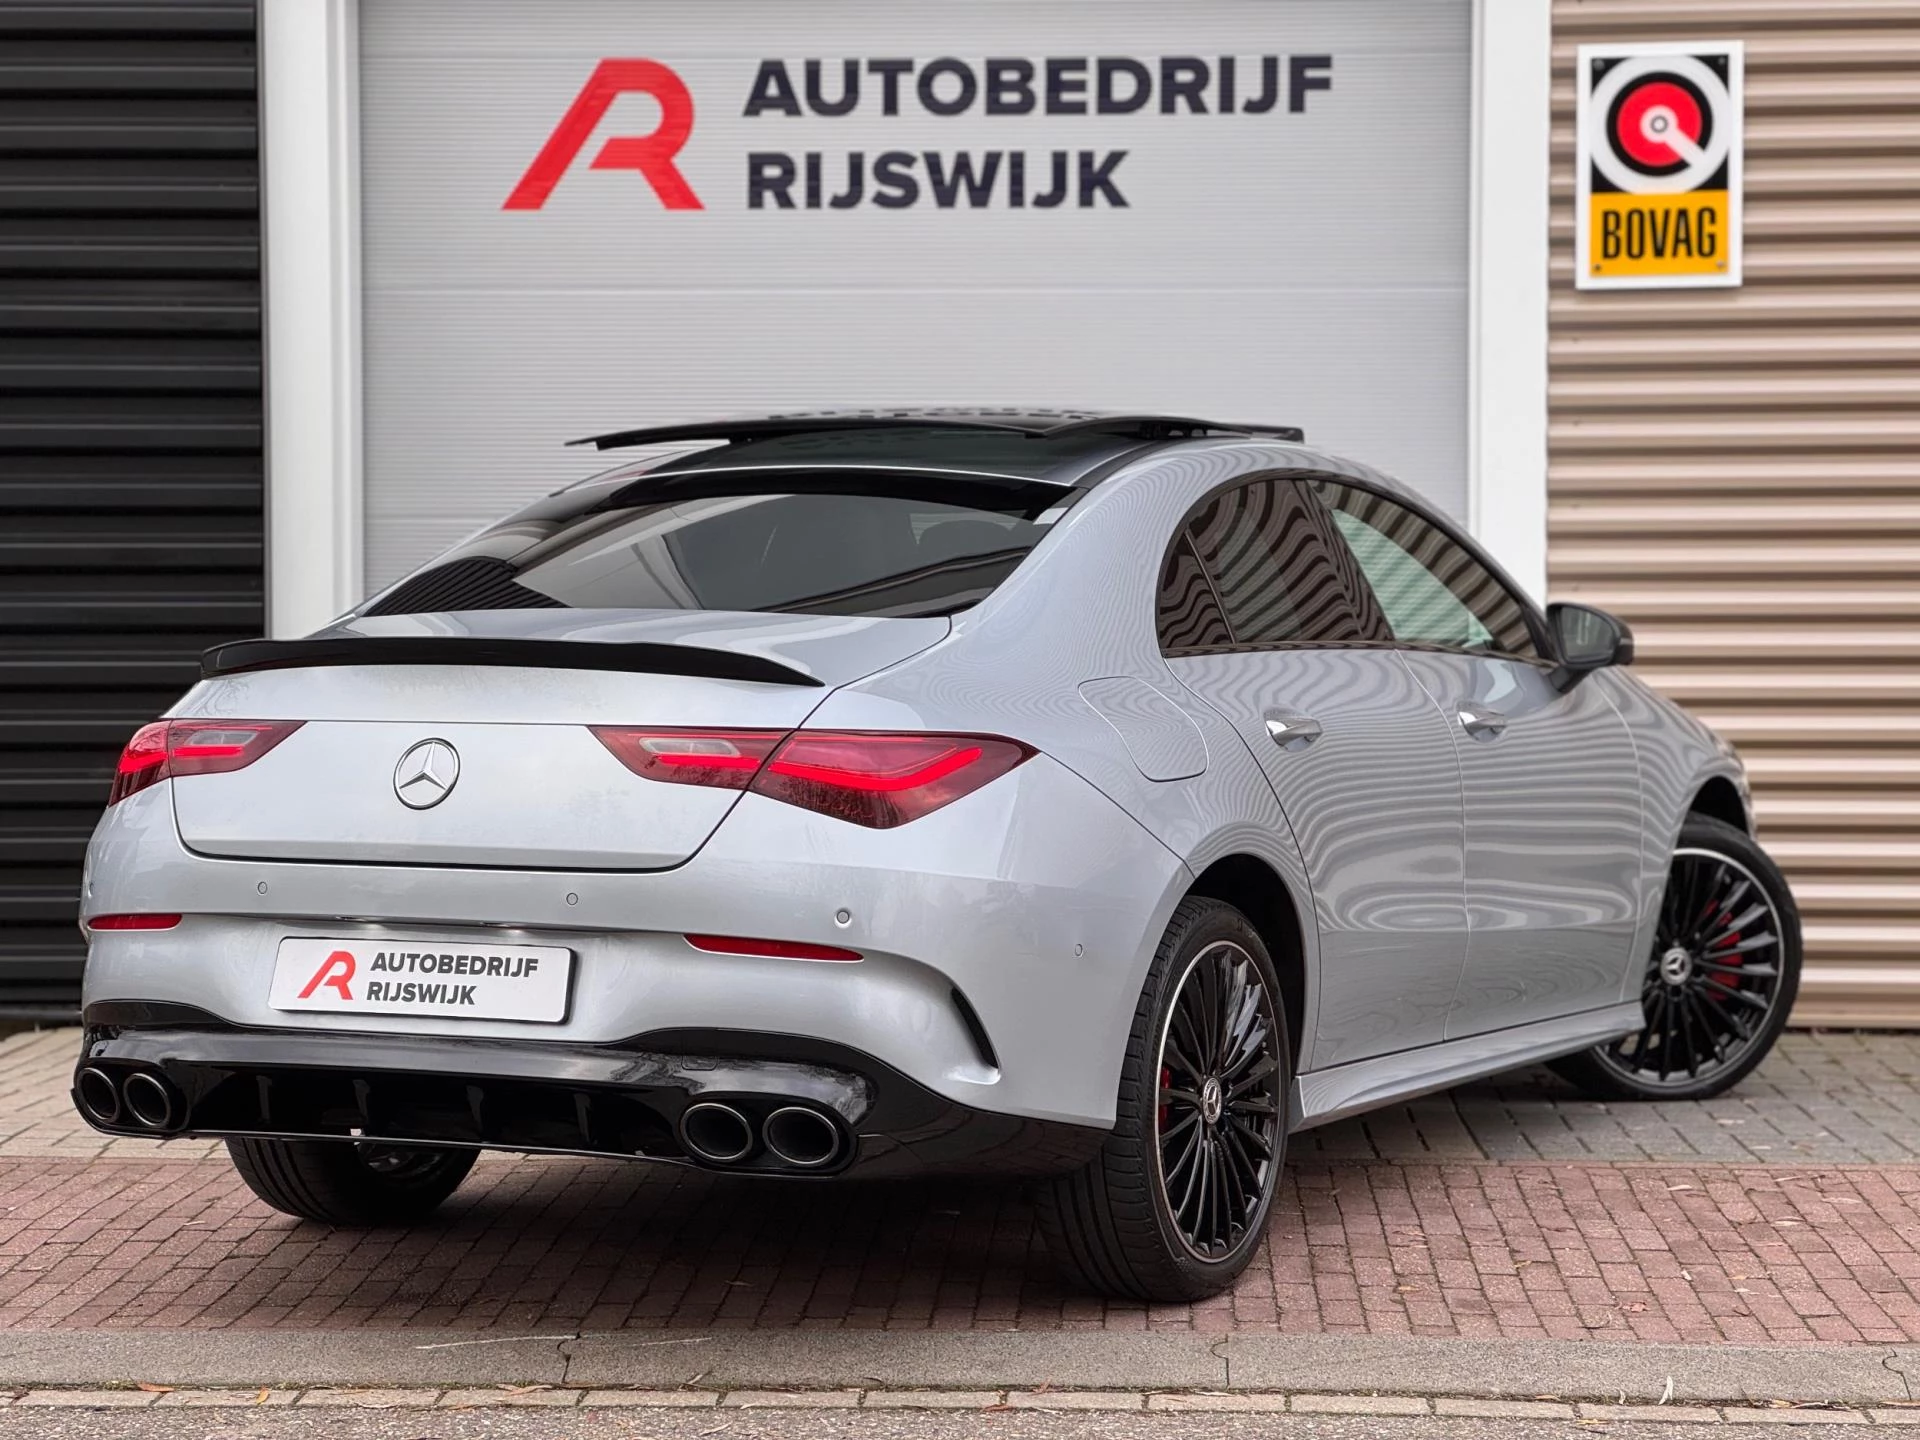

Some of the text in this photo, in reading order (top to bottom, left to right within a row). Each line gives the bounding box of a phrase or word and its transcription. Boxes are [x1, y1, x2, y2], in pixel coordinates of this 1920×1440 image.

[744, 55, 1332, 117] AUTOBEDRIJF
[748, 151, 1129, 210] RIJSWIJK
[1602, 206, 1717, 260] BOVAG
[370, 952, 539, 978] AUTOBEDRIJF
[366, 981, 477, 1005] RIJSWIJK
